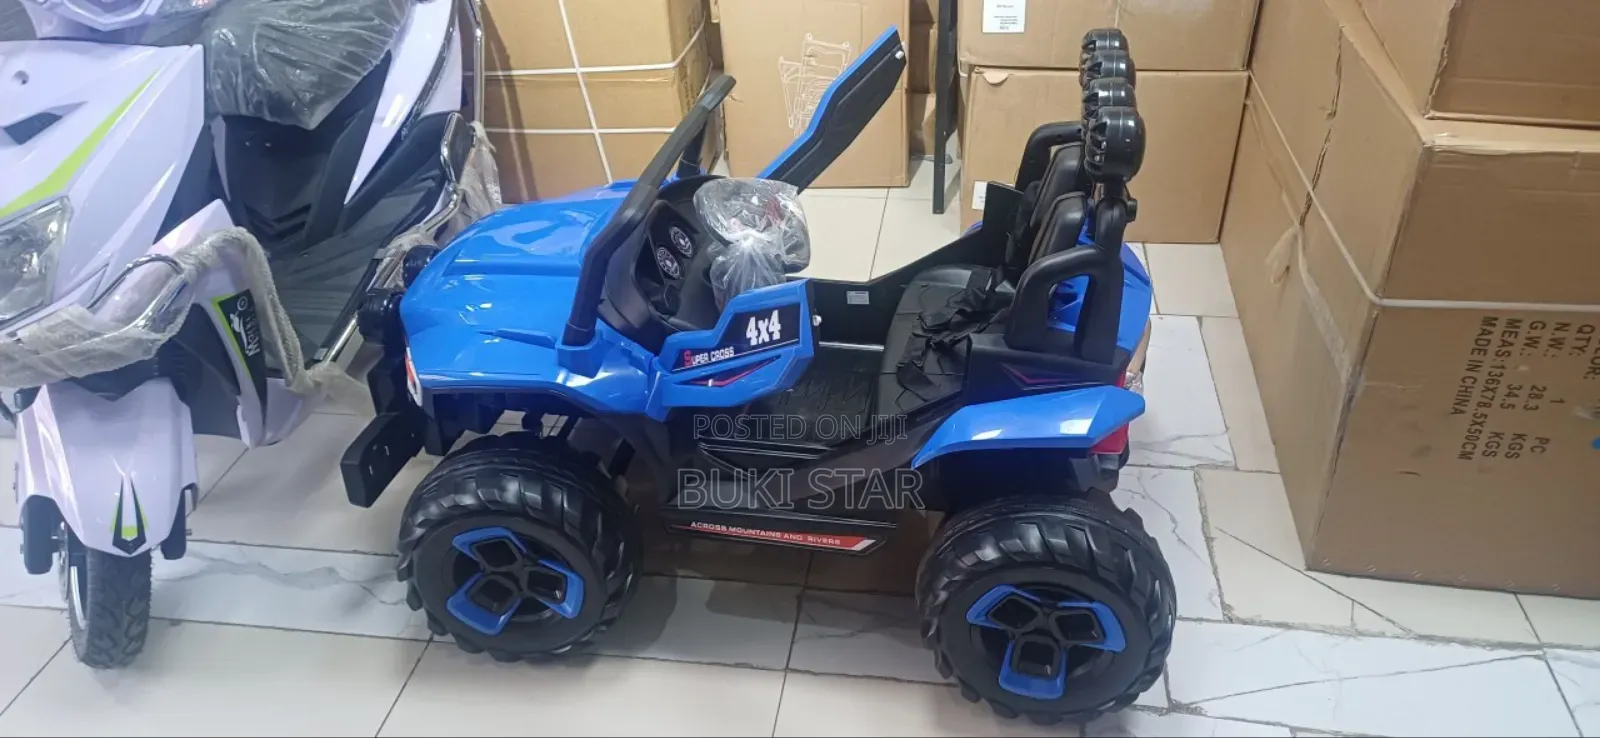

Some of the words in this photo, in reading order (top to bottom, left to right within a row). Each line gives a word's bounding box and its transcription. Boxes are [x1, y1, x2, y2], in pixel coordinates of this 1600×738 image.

[745, 309, 781, 346] 4x4
[1470, 316, 1499, 357] MADE
[1568, 324, 1596, 356] QTY:
[683, 349, 710, 367] SUPER
[710, 346, 735, 363] CROSS
[1465, 359, 1484, 373] IN
[1450, 375, 1478, 416] CHINA
[1500, 383, 1523, 410] 34.5
[1523, 384, 1547, 411] 28.3
[1482, 431, 1505, 458] KGS
[1504, 433, 1528, 459] KGS
[1530, 436, 1551, 454] PC
[690, 521, 727, 532] ACROSS
[729, 526, 781, 539] MOUNTAINS
[783, 532, 804, 542] AND
[807, 535, 841, 546] RIVERS
